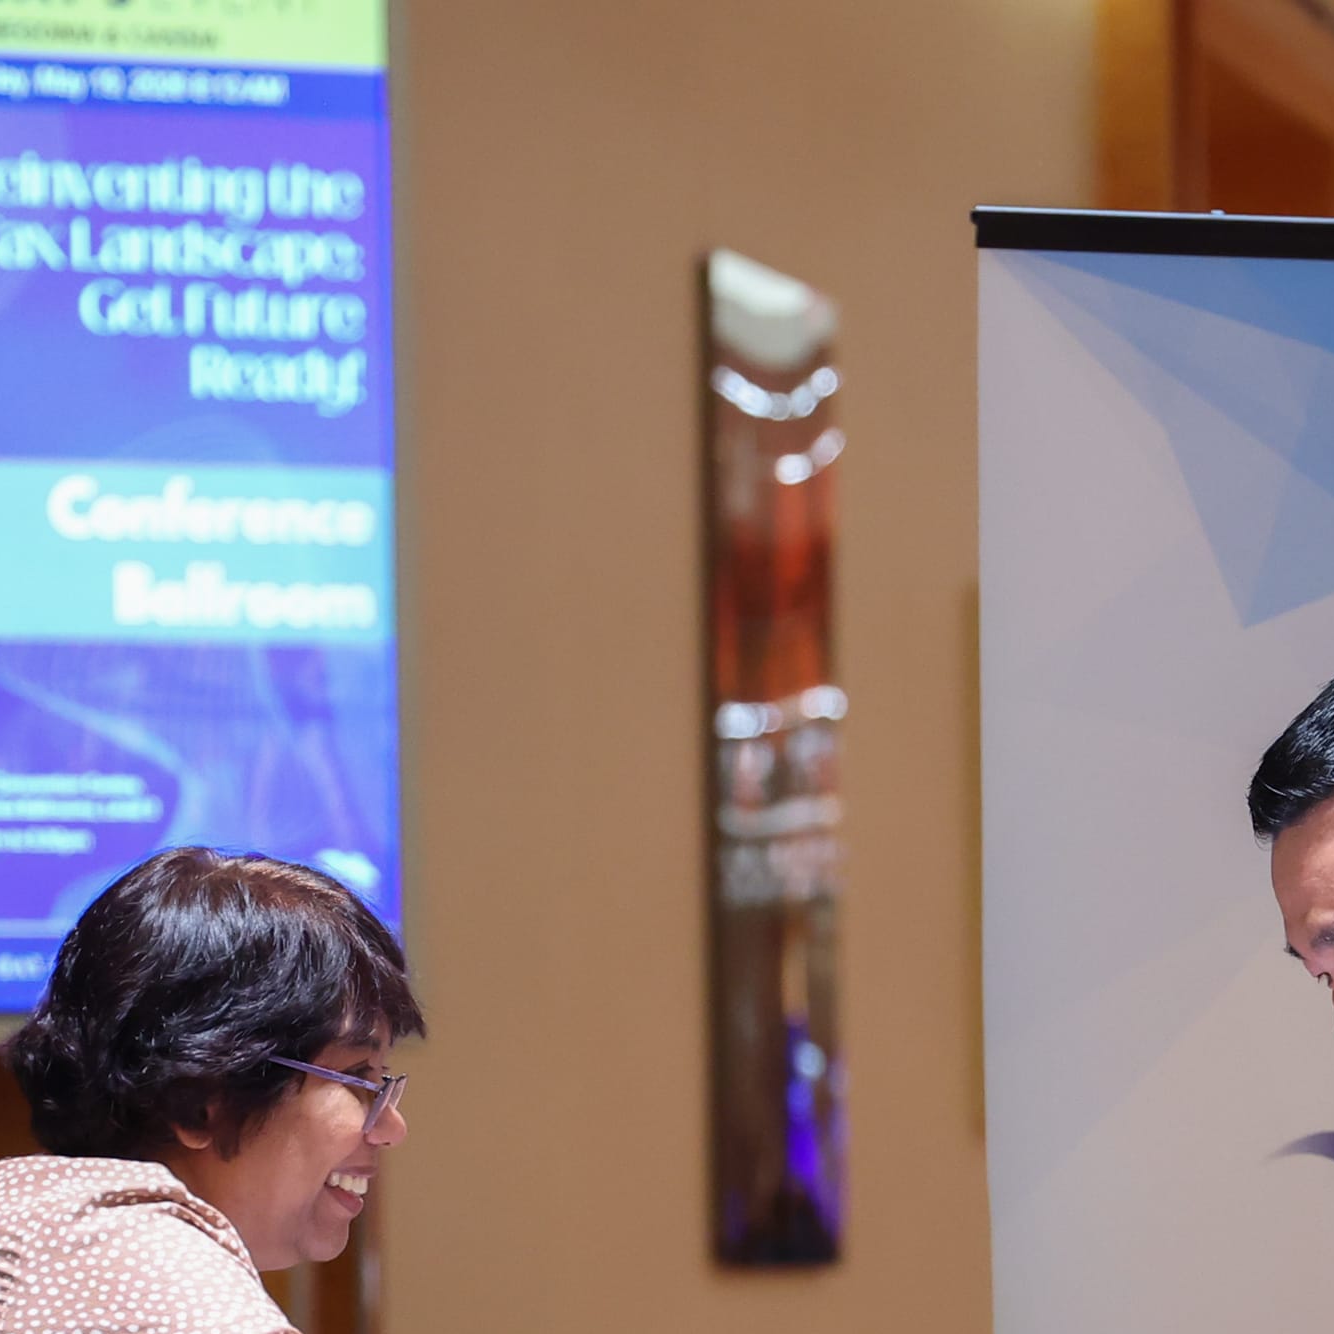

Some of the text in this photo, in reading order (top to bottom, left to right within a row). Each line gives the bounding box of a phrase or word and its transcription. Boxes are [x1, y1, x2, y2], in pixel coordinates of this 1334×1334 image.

[268, 162, 366, 220] the
[46, 474, 377, 547] Conference
[112, 558, 378, 628] Ballroom
